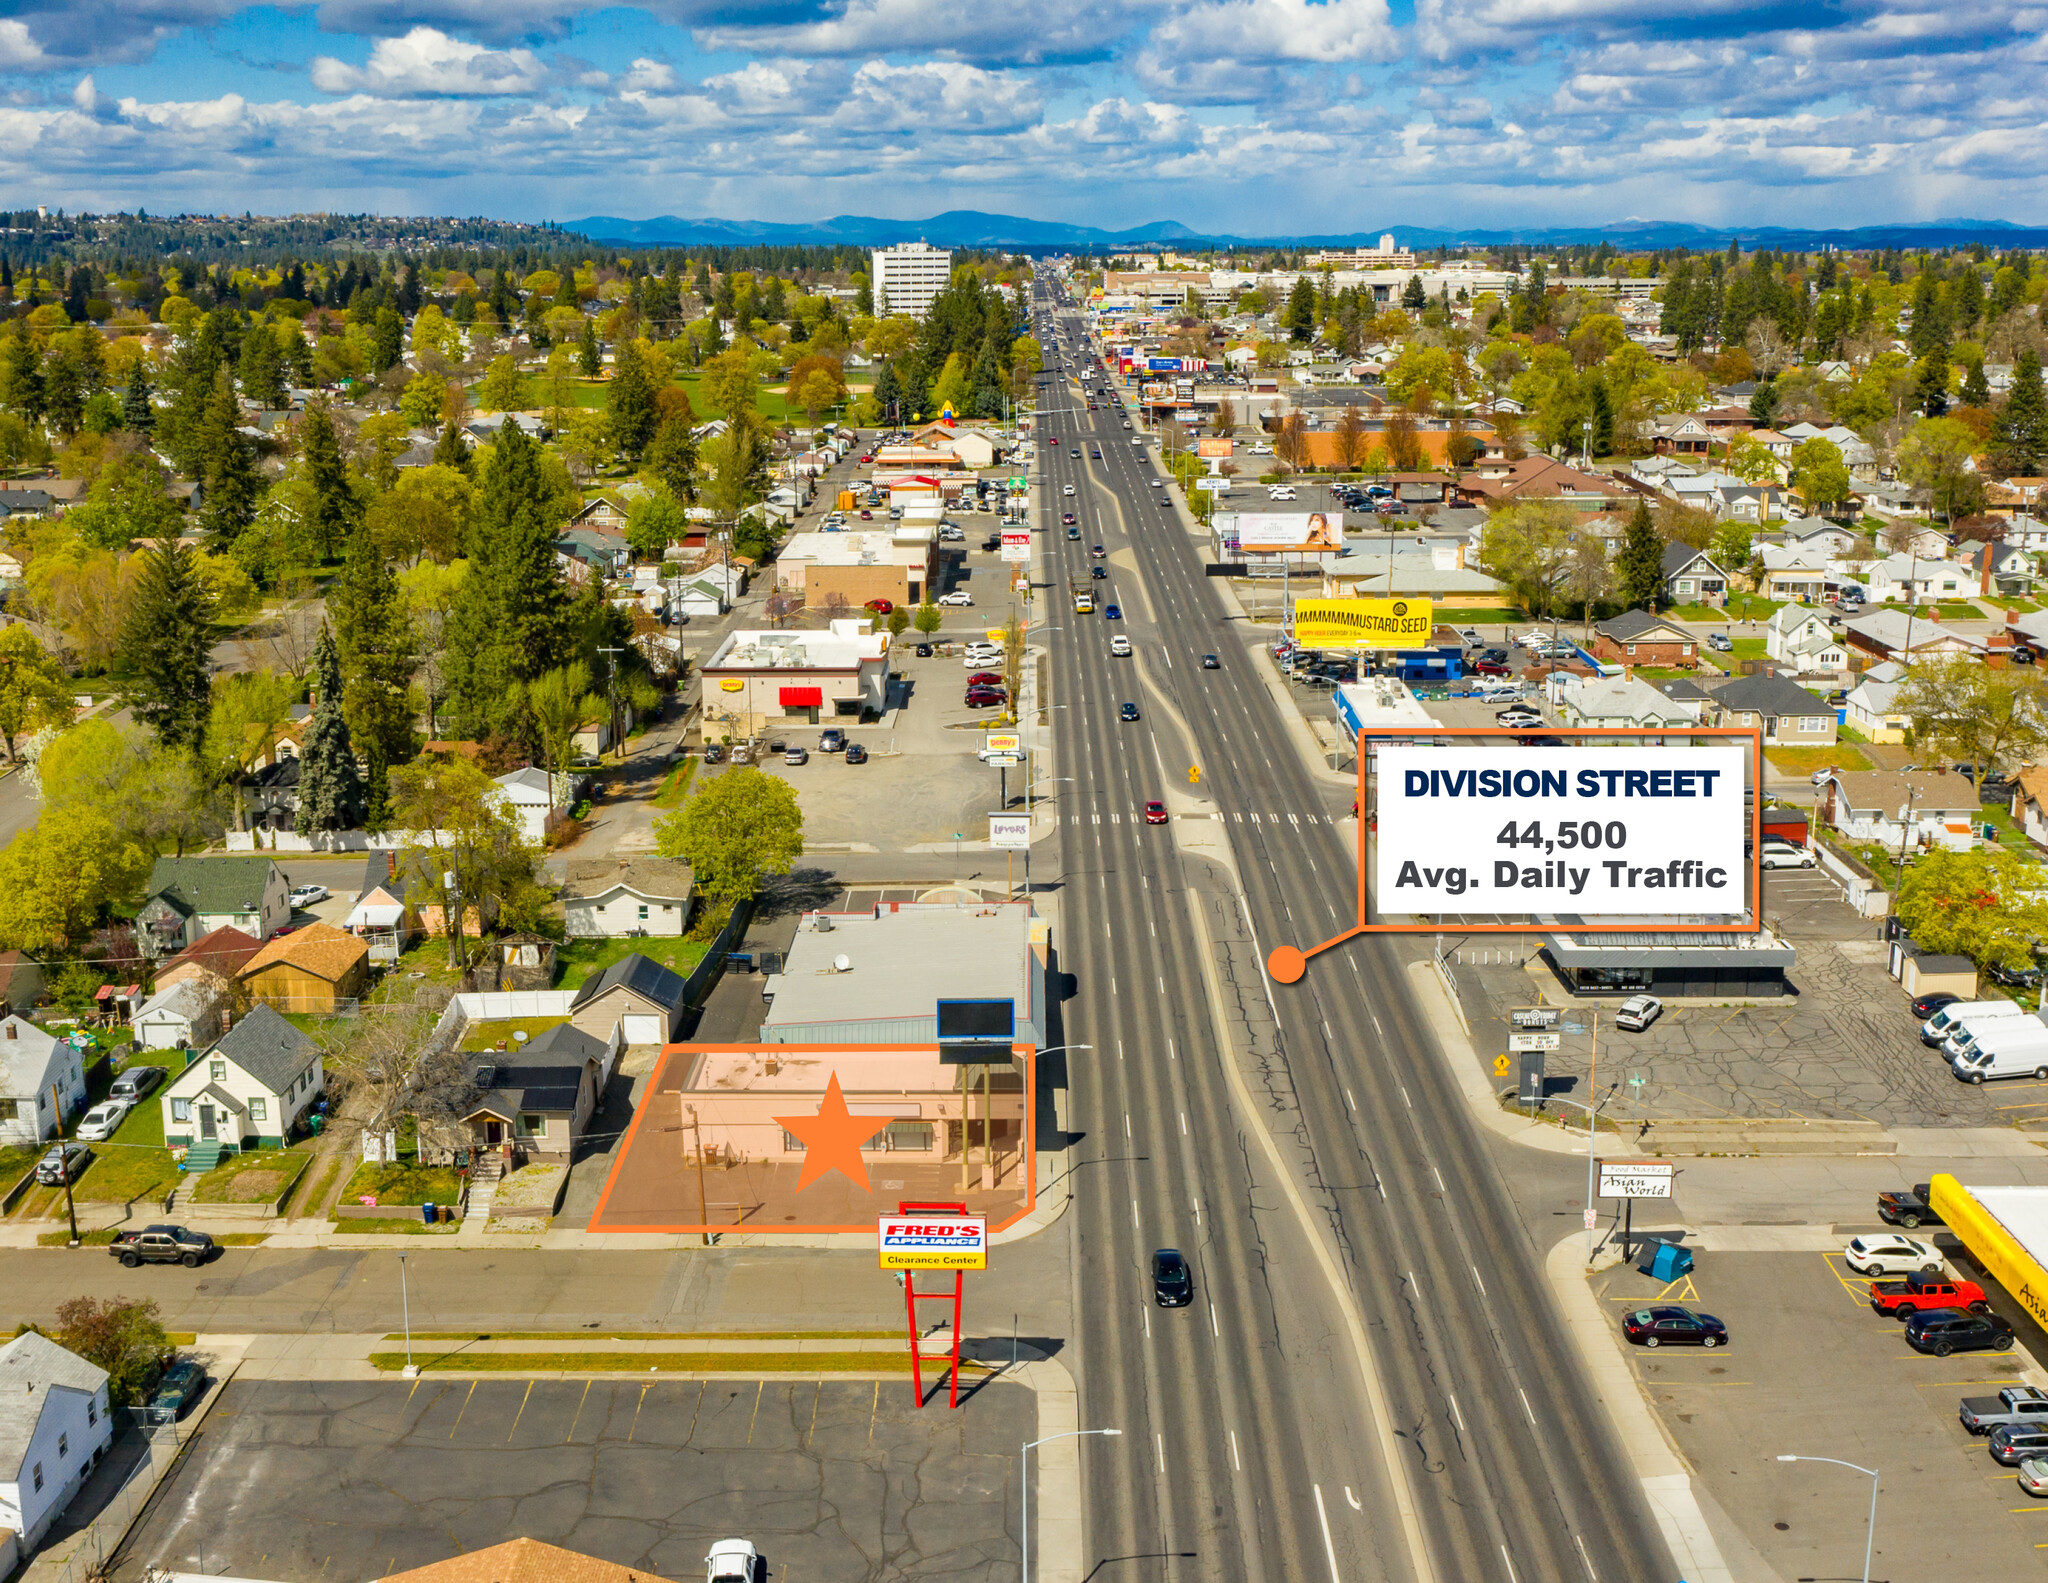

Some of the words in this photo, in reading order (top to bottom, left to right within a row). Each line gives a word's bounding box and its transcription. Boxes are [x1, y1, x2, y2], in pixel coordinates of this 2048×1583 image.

[1400, 617, 1427, 633] SEED
[1603, 1176, 1645, 1186] Asian
[1623, 1185, 1666, 1196] World
[886, 1225, 981, 1236] FRED'S
[886, 1237, 979, 1245] APPLIANCE
[887, 1256, 940, 1264] Clearance
[943, 1256, 978, 1264] Center
